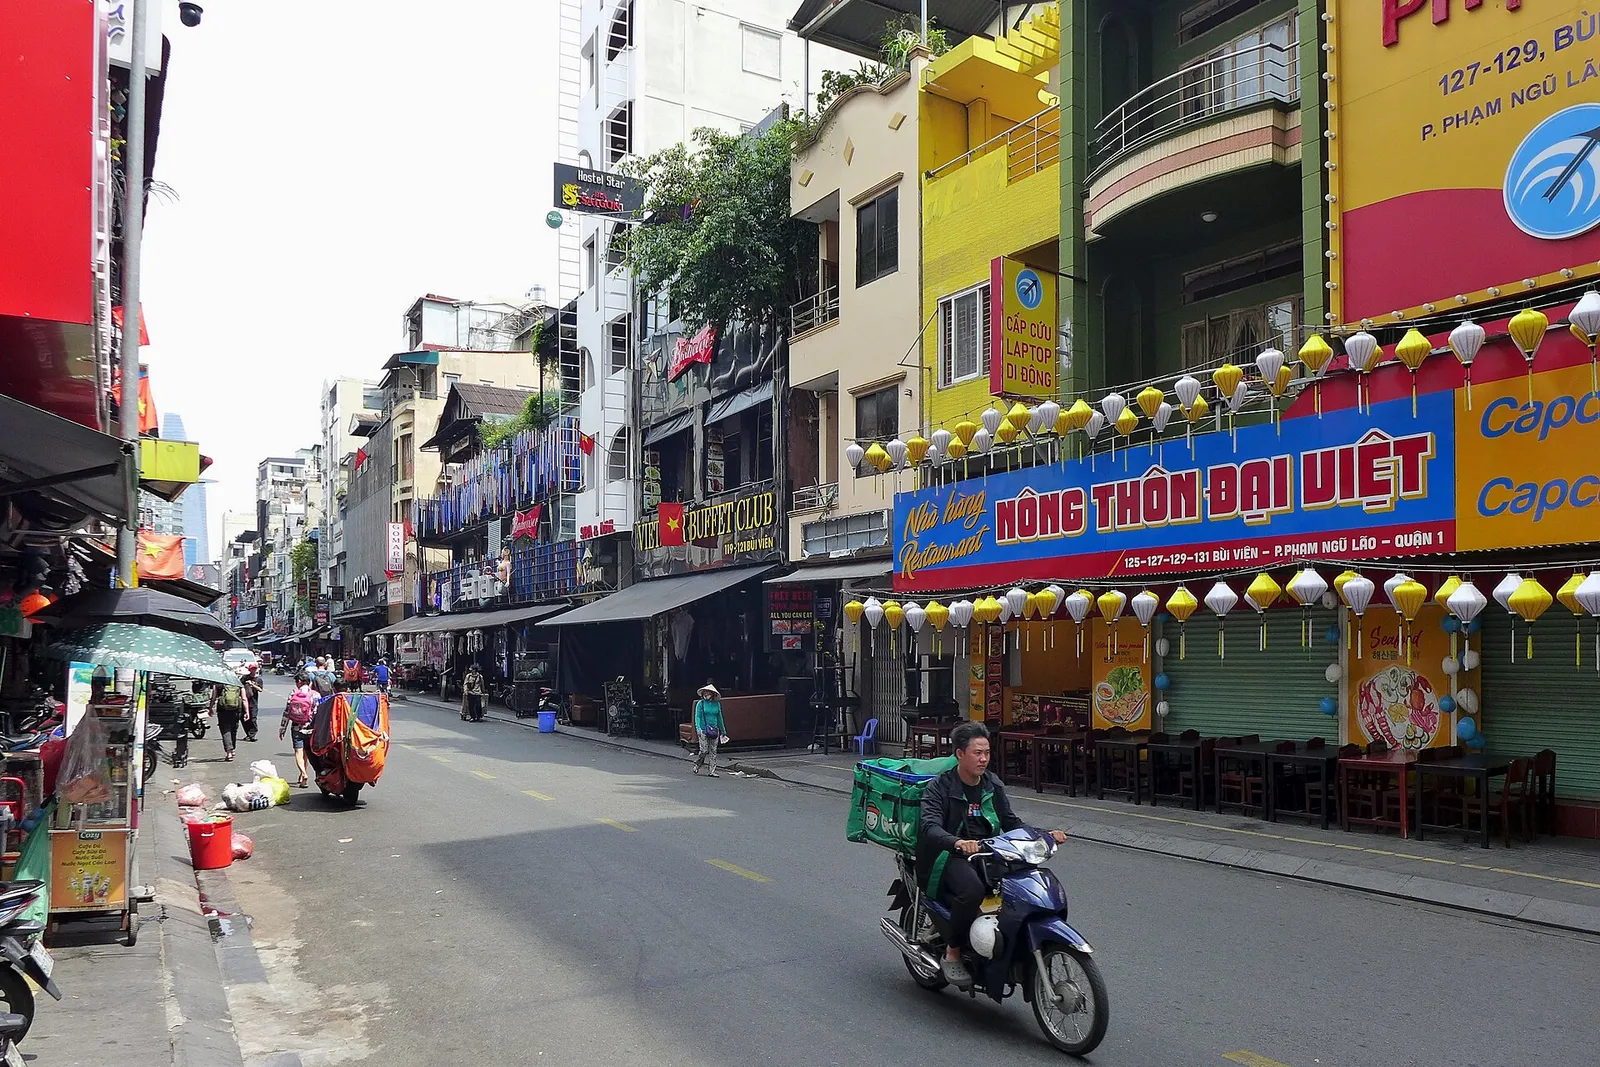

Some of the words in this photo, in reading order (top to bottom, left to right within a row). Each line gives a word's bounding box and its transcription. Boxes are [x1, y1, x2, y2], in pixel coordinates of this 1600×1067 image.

[1438, 39, 1545, 96] 127-129,
[1421, 123, 1437, 141] P.
[1442, 97, 1501, 134] PHẠM
[1511, 74, 1557, 108] NGŨ
[1566, 57, 1600, 88] LÃ
[578, 170, 604, 185] Hostel
[606, 176, 626, 189] Star
[1006, 311, 1027, 334] CẤP
[1030, 320, 1052, 342] CỨU
[1006, 338, 1052, 364] LAPTOP
[1006, 362, 1017, 380] DI
[1020, 364, 1052, 388] ĐỘNG
[690, 502, 734, 541] BUFFET
[736, 491, 774, 533] CLUB
[903, 500, 939, 542] Nhà
[942, 489, 987, 530] hàng
[995, 485, 1088, 545] NÔNG
[1090, 464, 1202, 533] THÔN
[1203, 453, 1294, 526] ĐẠI
[1477, 474, 1600, 522] Capc
[580, 525, 593, 540] SPA
[899, 524, 990, 580] Restaurant
[1322, 537, 1347, 553] NGŨ
[1352, 535, 1377, 552] LÃO
[1395, 530, 1433, 550] QUẬN
[1437, 531, 1444, 545] 1
[770, 611, 781, 619] ALL
[781, 611, 792, 619] YOU
[792, 611, 803, 619] CAN
[803, 611, 813, 619] EAT
